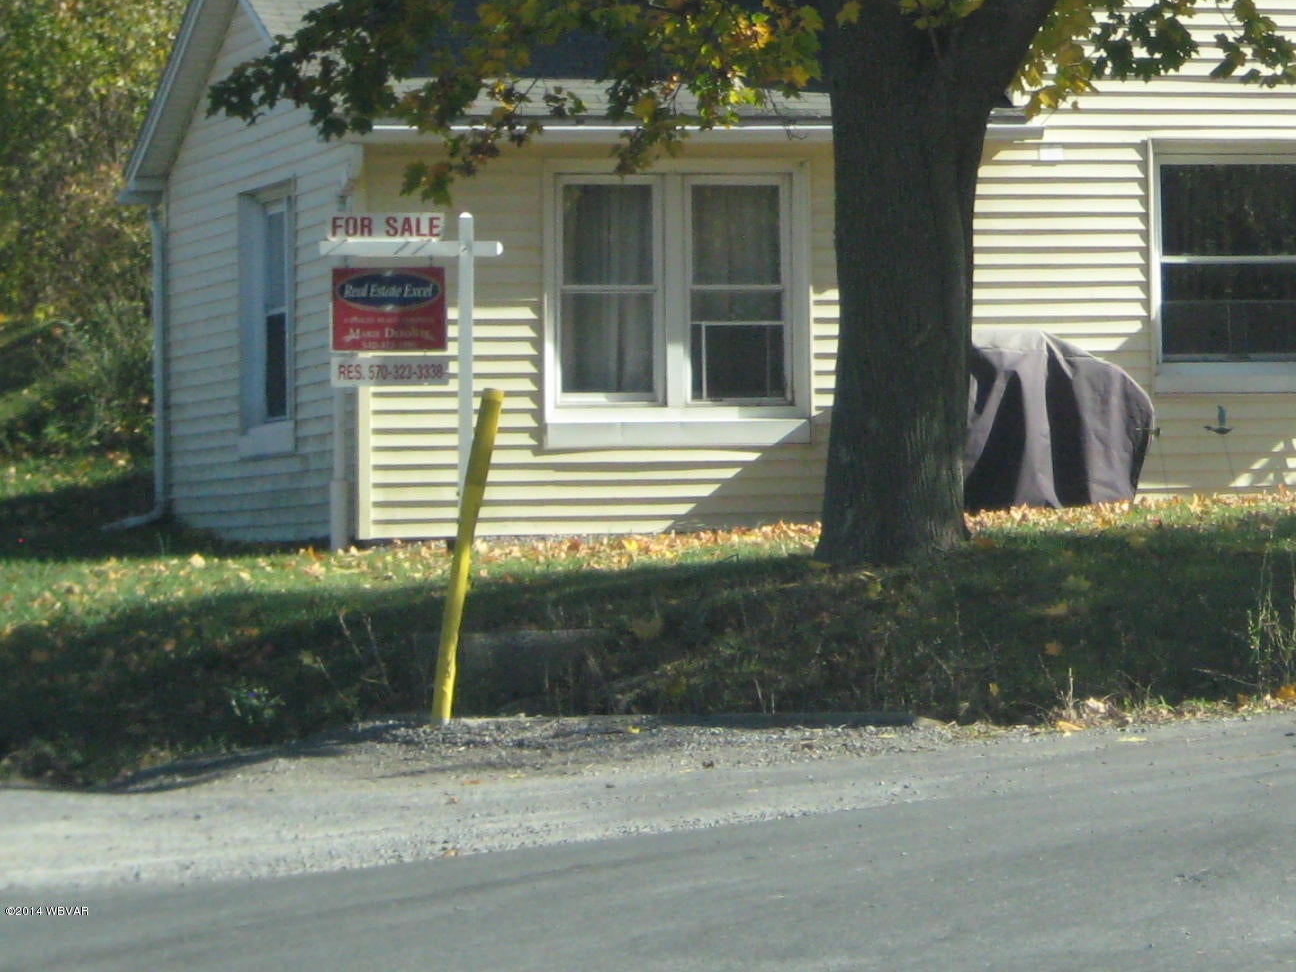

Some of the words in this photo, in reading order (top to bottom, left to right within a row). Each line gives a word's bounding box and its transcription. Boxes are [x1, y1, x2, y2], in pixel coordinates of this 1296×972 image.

[331, 216, 373, 237] FOR
[385, 216, 441, 237] SALE
[343, 284, 369, 298] Real
[369, 284, 402, 298] Estate
[403, 283, 434, 298] Excel
